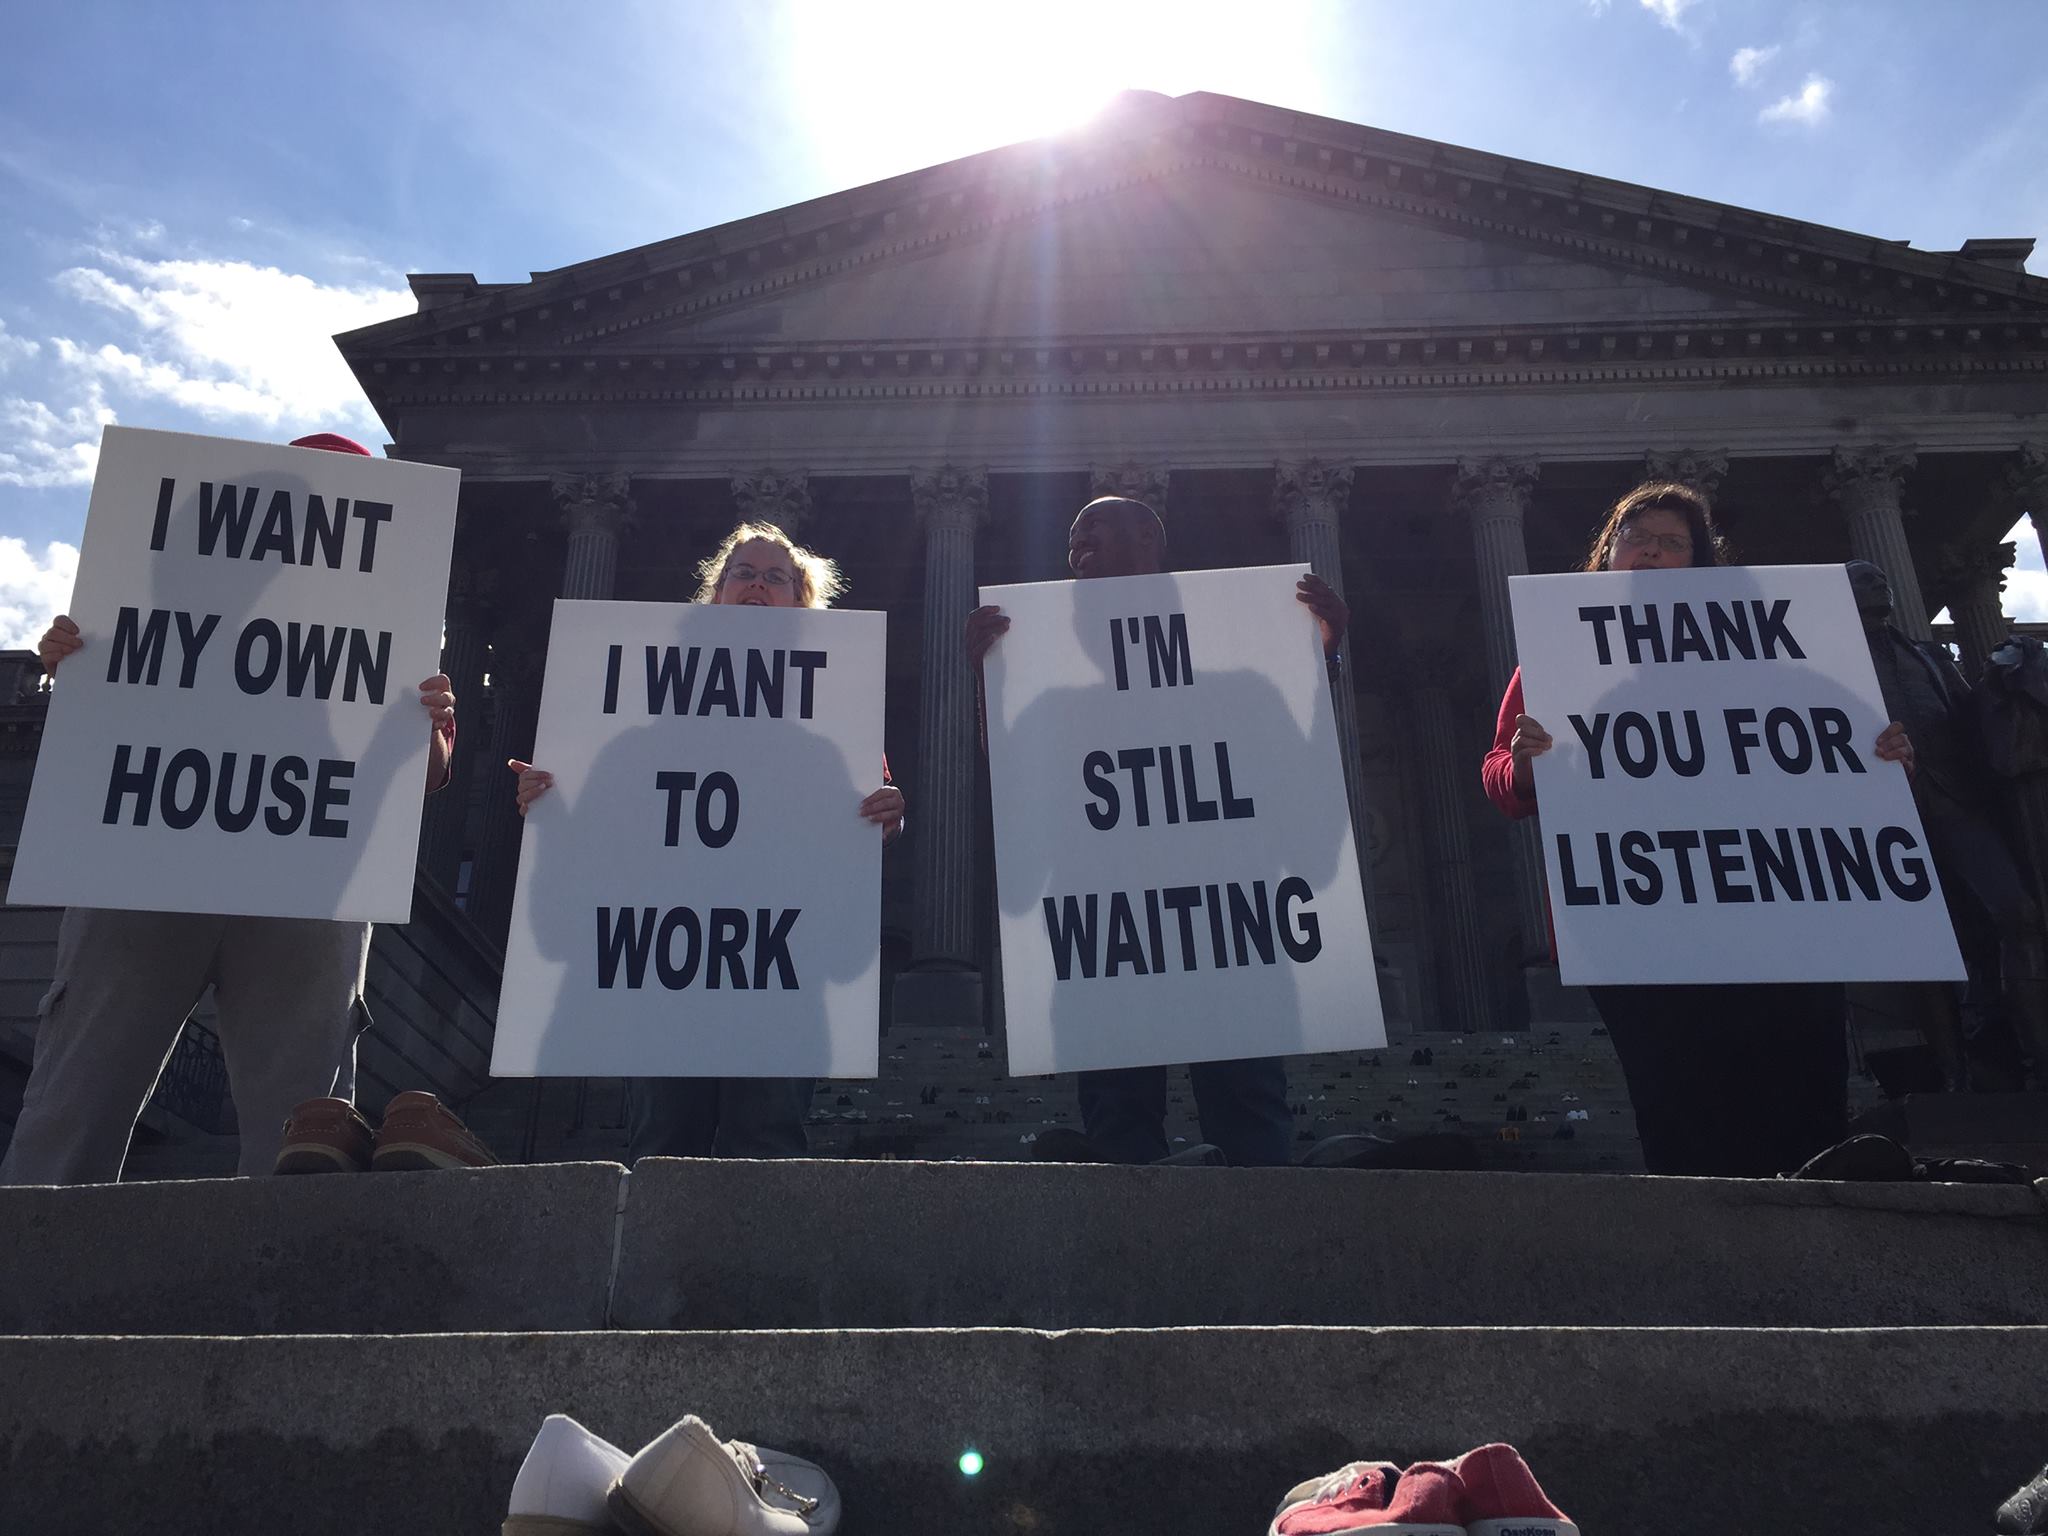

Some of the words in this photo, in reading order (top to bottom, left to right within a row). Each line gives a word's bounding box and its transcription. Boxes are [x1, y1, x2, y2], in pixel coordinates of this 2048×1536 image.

[150, 478, 175, 551] I
[198, 482, 393, 572] WANT
[107, 607, 221, 688] MY
[234, 618, 392, 705] OWN
[1110, 614, 1193, 691] I'M
[1579, 600, 1806, 665] THANK
[603, 645, 622, 714] I
[646, 646, 827, 719] WANT
[1567, 710, 1706, 779] YOU
[1723, 707, 1867, 774] FOR
[102, 745, 355, 838] HOUSE
[656, 771, 739, 848] TO
[1083, 742, 1255, 830] STILL
[1556, 826, 1932, 905] LISTENING
[597, 907, 801, 990] WORK
[1043, 877, 1322, 980] WAITING
